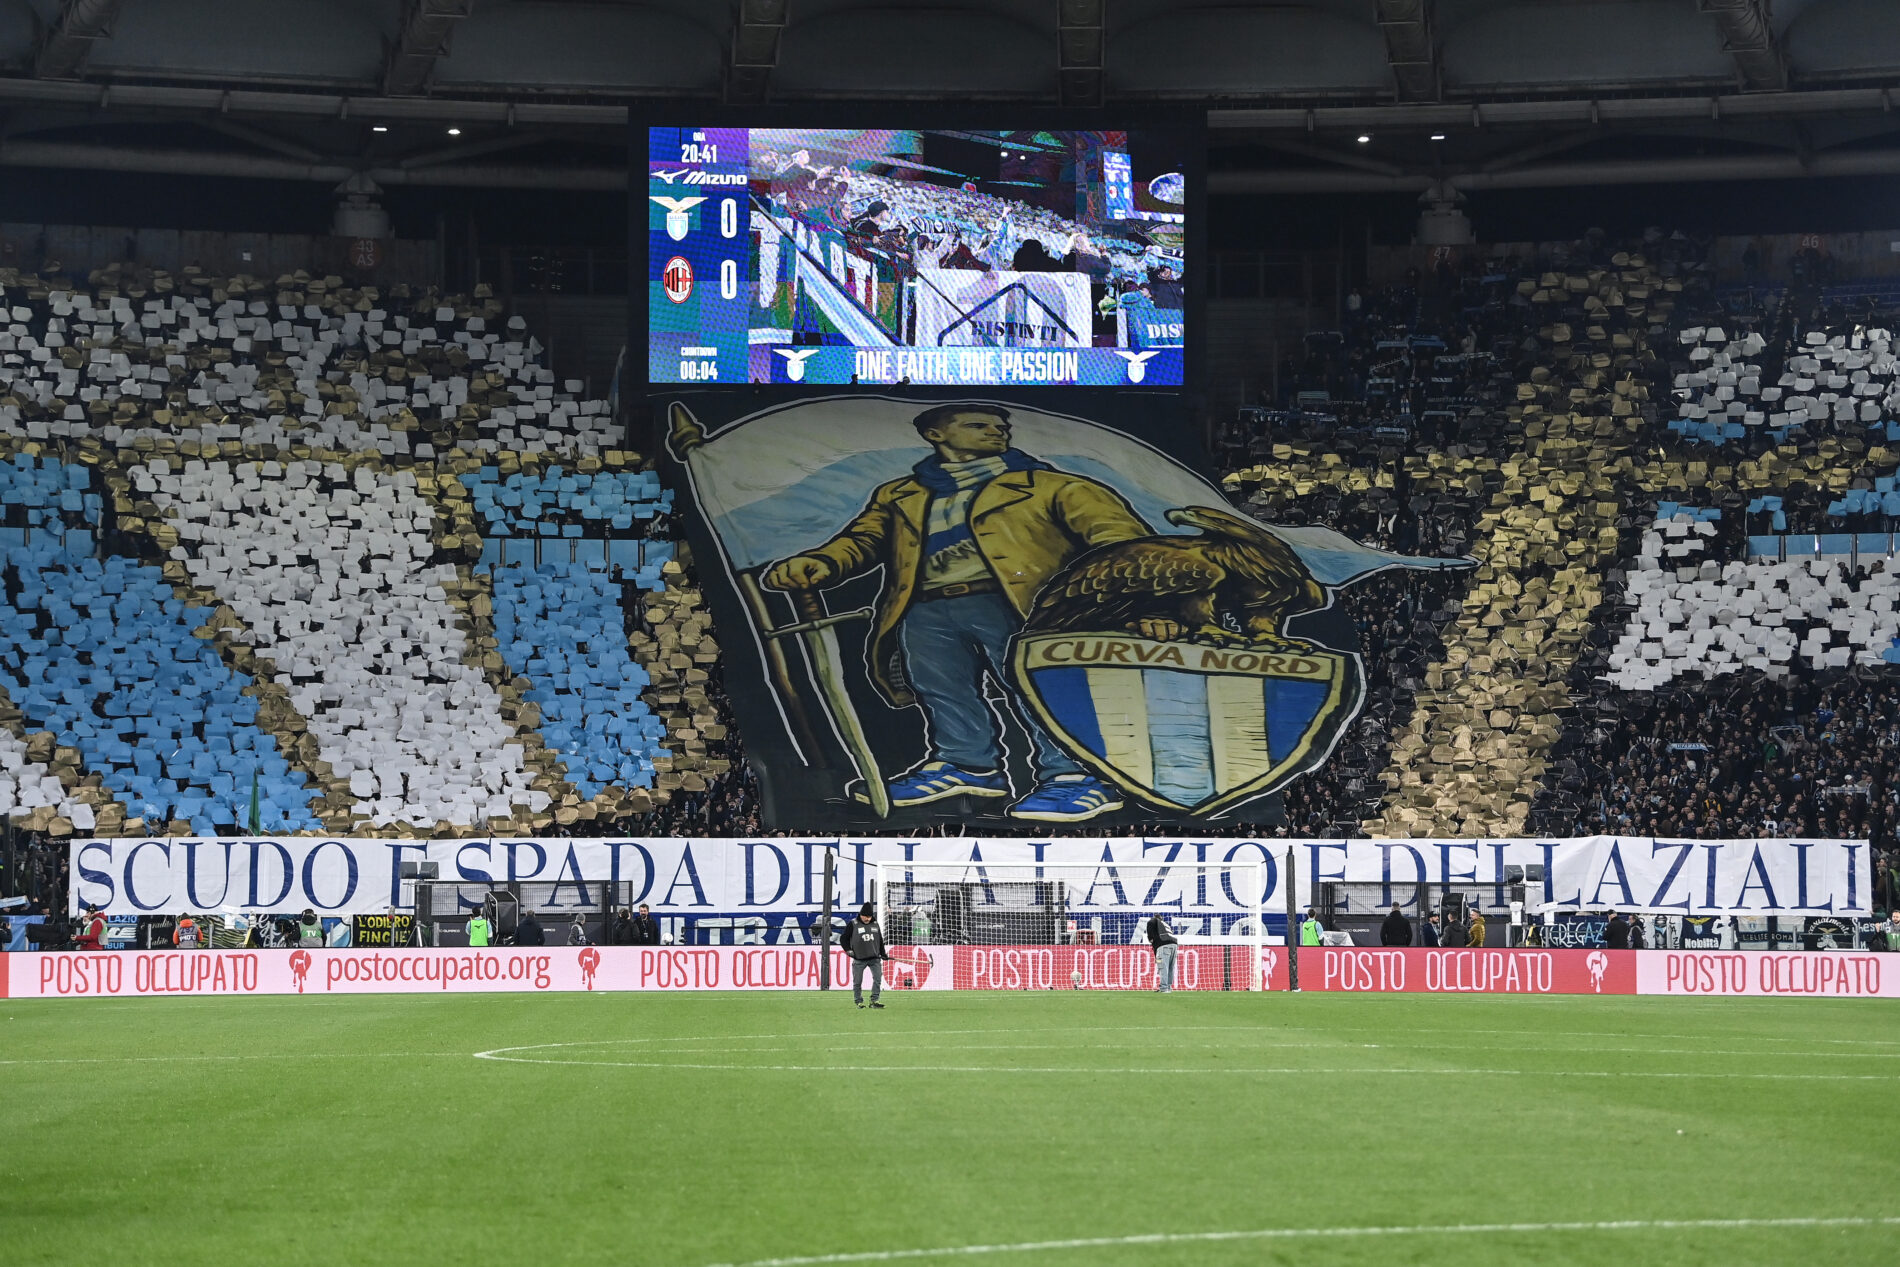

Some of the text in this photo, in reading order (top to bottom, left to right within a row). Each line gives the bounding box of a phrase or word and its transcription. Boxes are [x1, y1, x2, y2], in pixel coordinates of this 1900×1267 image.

[681, 144, 718, 163] 20:41
[721, 198, 737, 239] 0
[1801, 235, 1819, 249] 46
[721, 259, 737, 300] 0
[680, 360, 719, 380] 00:04
[854, 350, 892, 381] ONE
[959, 351, 995, 381] ONE
[1001, 351, 1078, 381] PASSION
[1041, 640, 1321, 675] CURVA NORD
[77, 837, 358, 913] SCUDO
[385, 840, 428, 910] E
[455, 837, 715, 914] SPADA
[1027, 836, 1278, 914] LAZIO
[1303, 840, 1349, 912] E
[1375, 839, 1511, 912] DEI
[1535, 837, 1864, 915] LAZIALI
[108, 915, 138, 924] LAZIO
[861, 933, 875, 942] 134
[1771, 933, 1803, 941] ROMAA
[40, 953, 259, 995] POSTO OCCUPATO
[327, 952, 552, 989] postoccupato.org
[641, 949, 720, 989] POSTO
[972, 949, 1054, 989] POSTO
[1324, 950, 1553, 992] POSTO OCCUPATO
[1667, 953, 1881, 995] POSTO OCCUPATO
